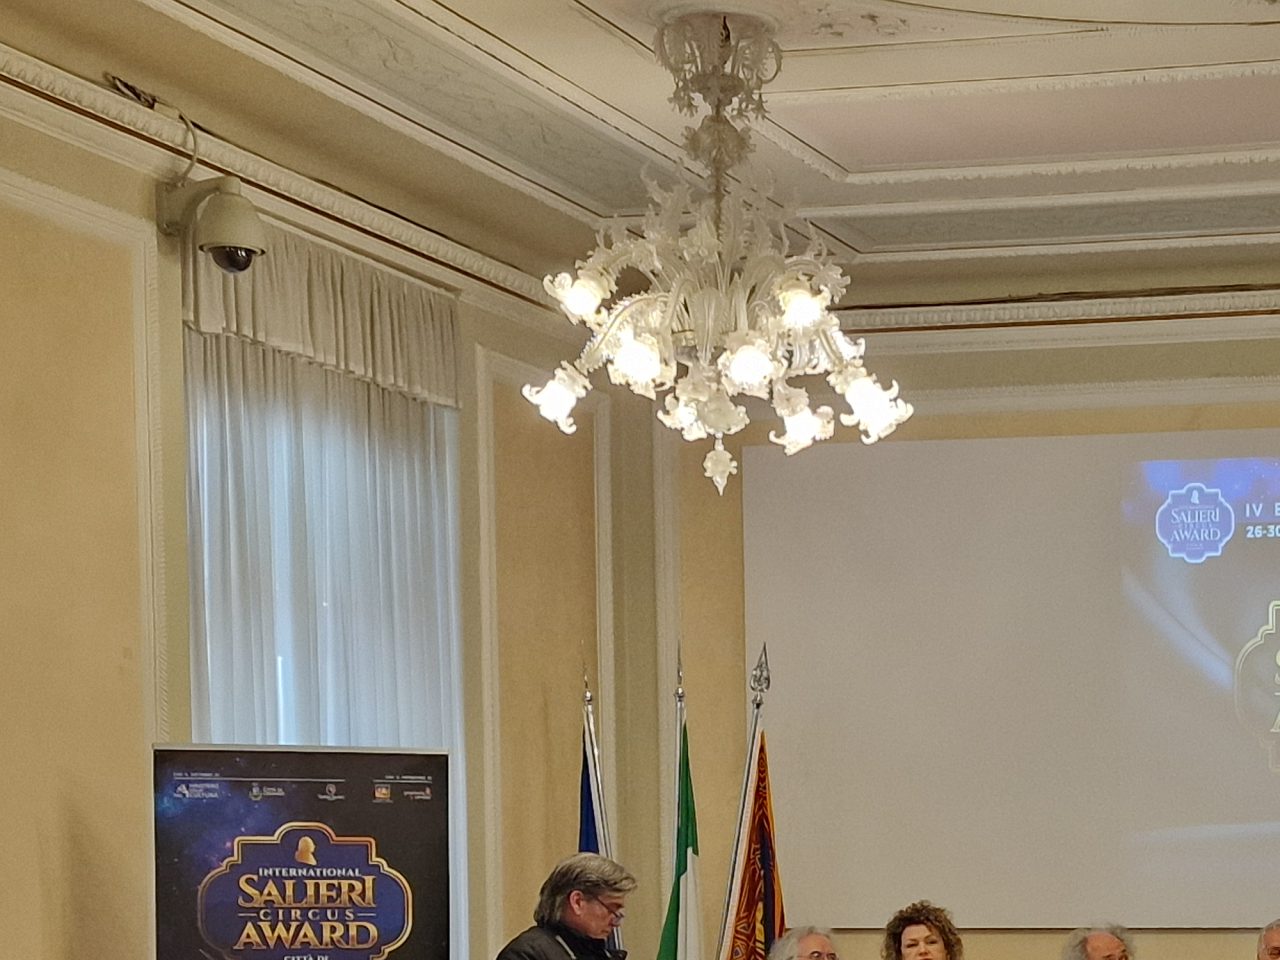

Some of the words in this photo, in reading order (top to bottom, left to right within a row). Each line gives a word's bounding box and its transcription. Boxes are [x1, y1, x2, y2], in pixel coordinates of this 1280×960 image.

[1171, 508, 1219, 523] SALIERI
[1246, 503, 1263, 517] IV
[1170, 529, 1220, 542] AWARD
[259, 867, 361, 877] INTERNATIONAL
[237, 874, 377, 908] SALIERI
[259, 909, 354, 921] CIRCUS
[233, 921, 378, 950] AWARD
